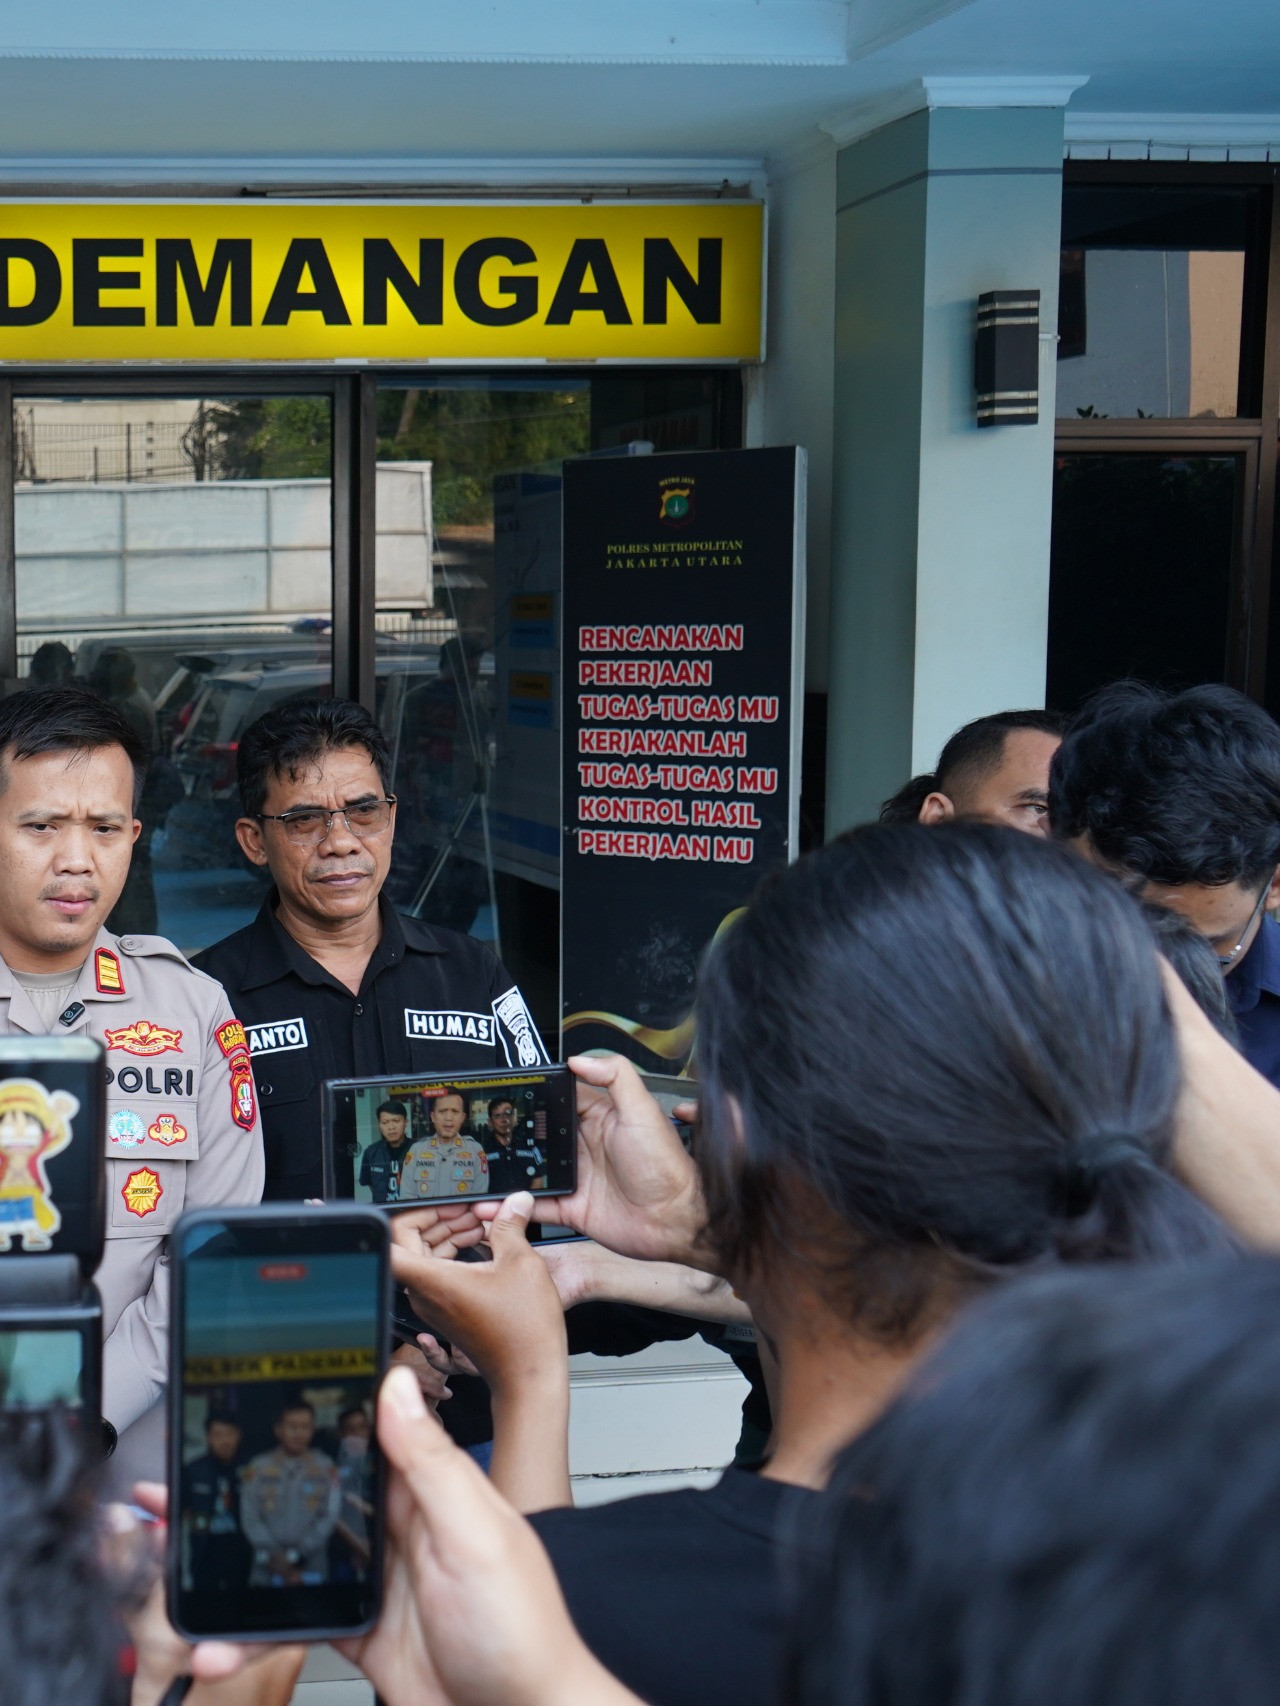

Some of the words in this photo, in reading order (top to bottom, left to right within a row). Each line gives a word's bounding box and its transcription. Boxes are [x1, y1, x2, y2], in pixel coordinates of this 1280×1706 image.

[607, 544, 650, 555] POLRES
[652, 540, 744, 553] METROPOLITAN
[606, 557, 681, 570] JAKARTA
[686, 555, 743, 568] UTARA
[578, 624, 744, 652] RENCANAKAN
[578, 660, 712, 690] PEKERJAAN
[578, 695, 736, 722] TUGAS-TUGAS
[738, 696, 779, 723] MU
[578, 729, 747, 758] KERJAKANLAH
[578, 762, 735, 790] TUGAS-TUGAS
[737, 766, 778, 794] MU
[578, 797, 688, 825] KONTROL
[692, 800, 761, 829] HASIL
[578, 830, 711, 862] PEKERJAAN
[714, 837, 754, 864] MU
[249, 1024, 301, 1052] ANTO
[412, 1014, 489, 1040] HUMAS
